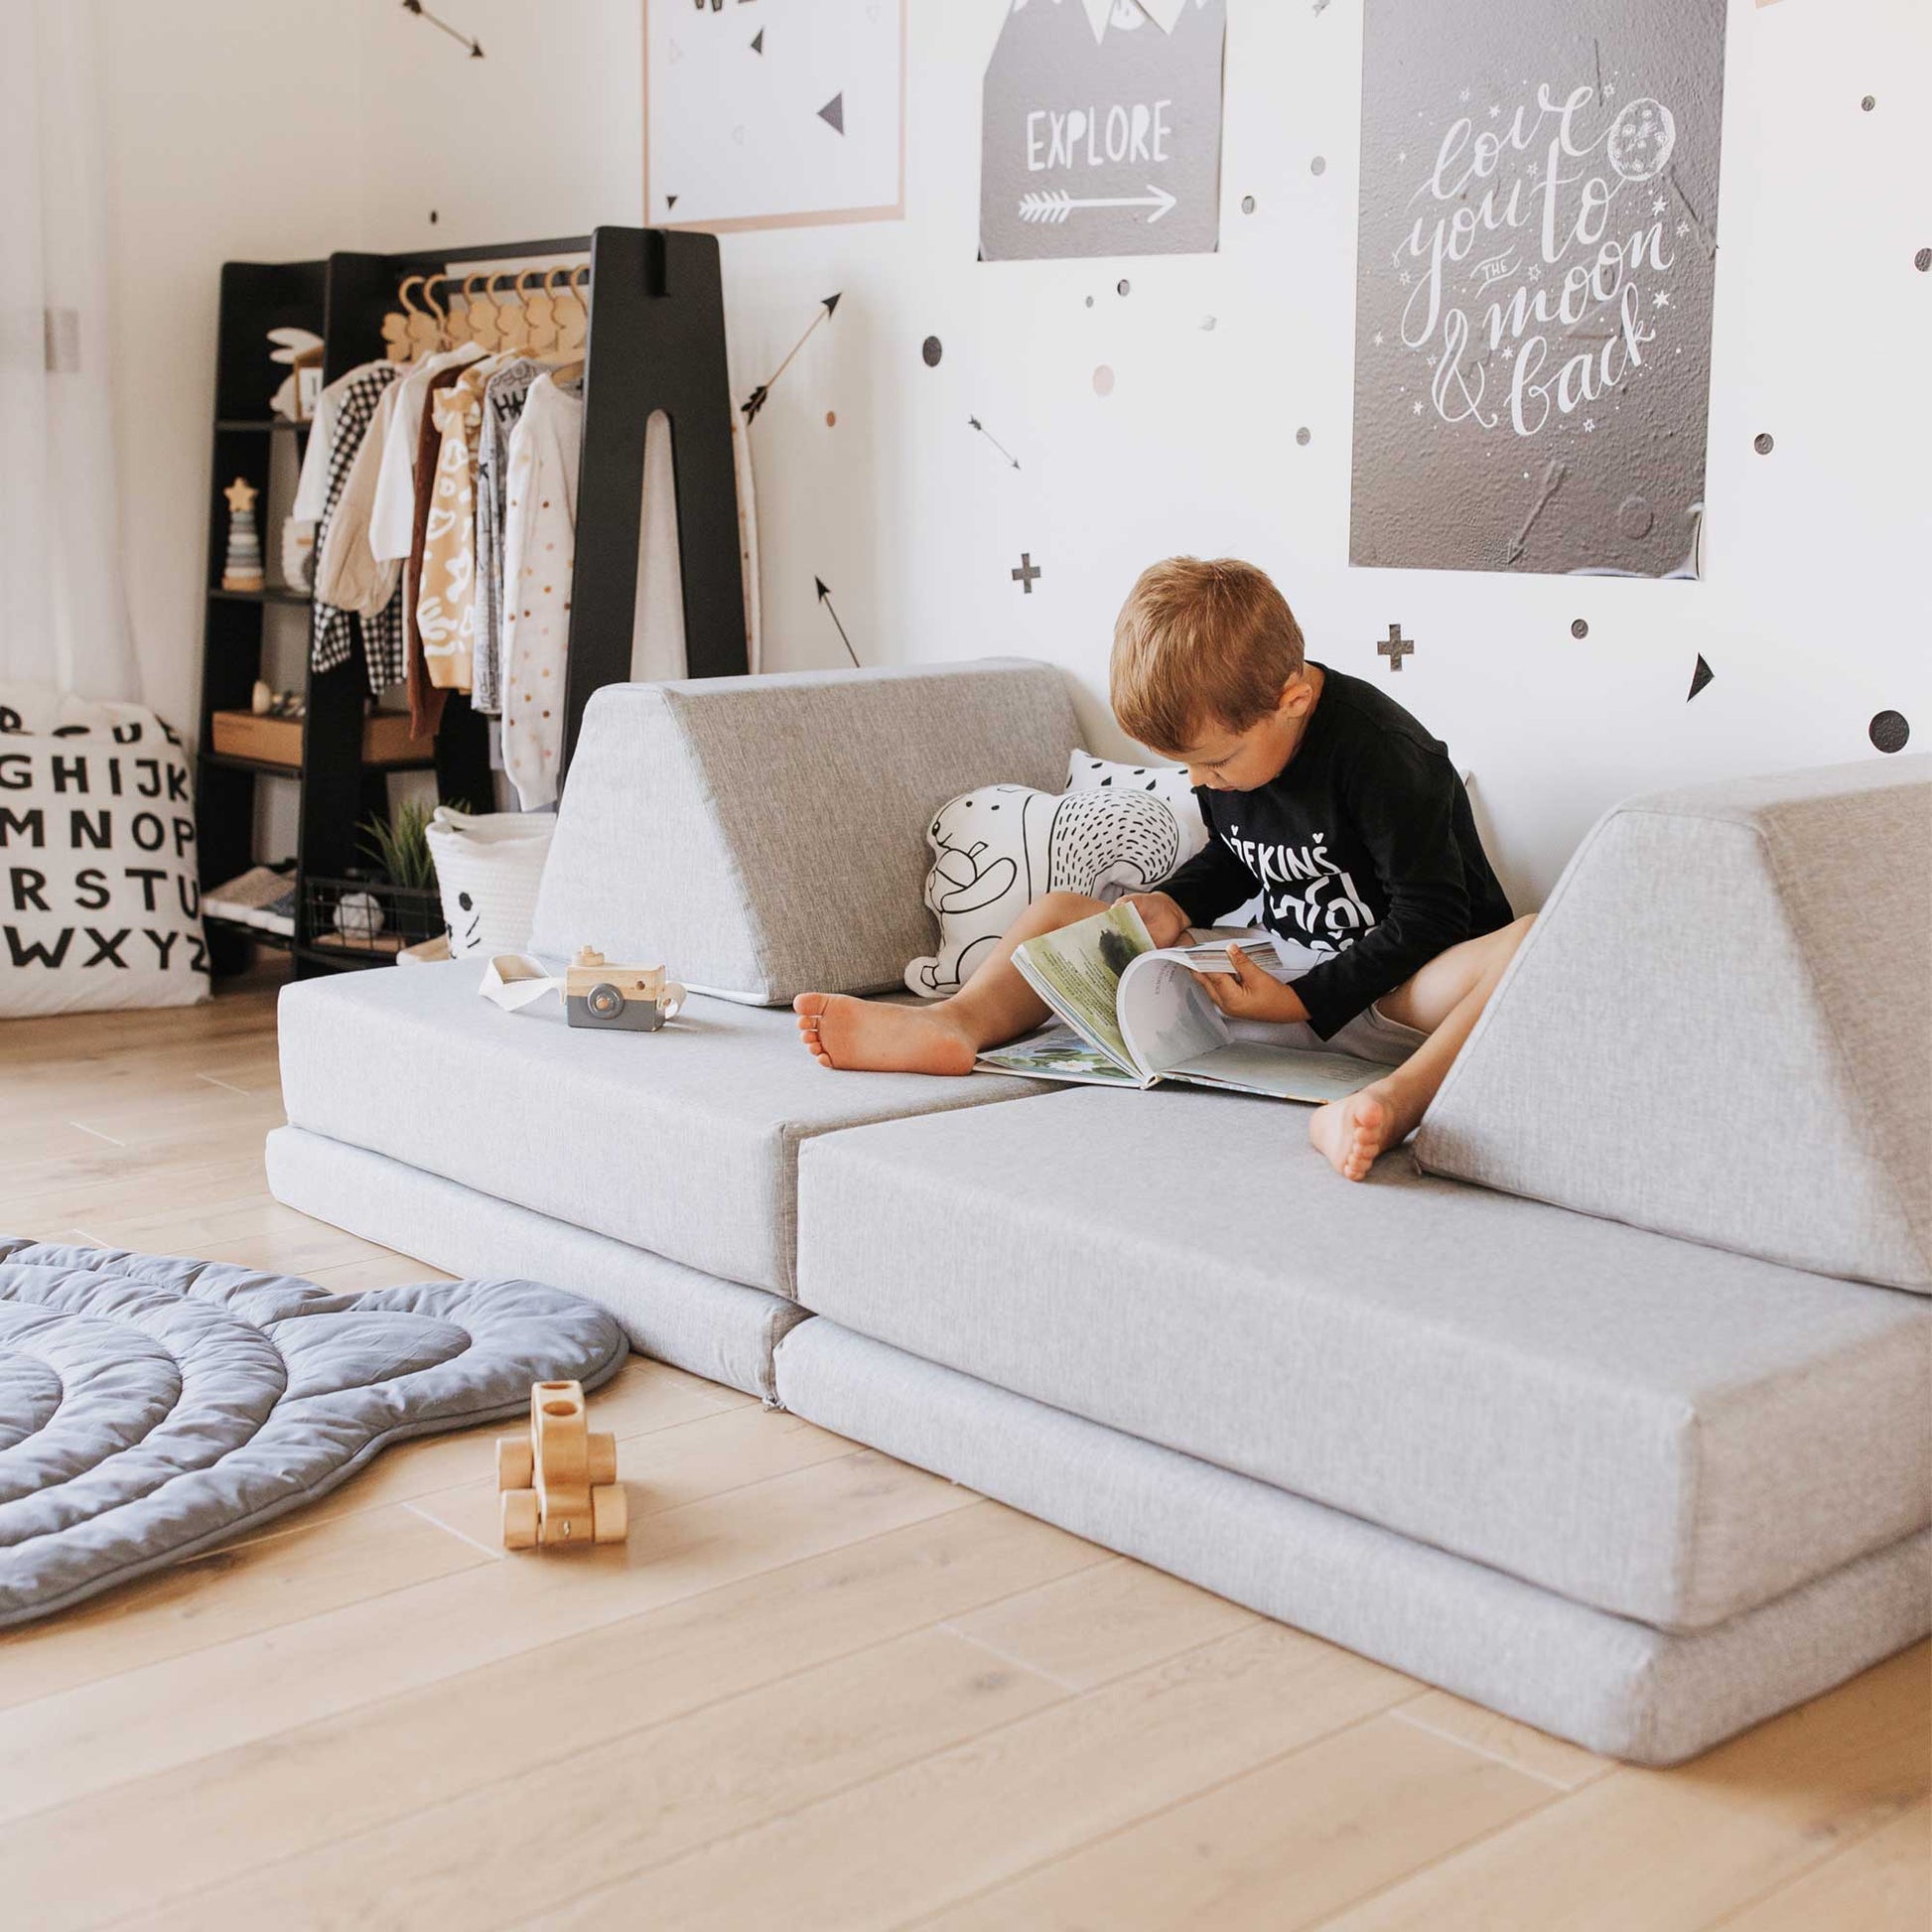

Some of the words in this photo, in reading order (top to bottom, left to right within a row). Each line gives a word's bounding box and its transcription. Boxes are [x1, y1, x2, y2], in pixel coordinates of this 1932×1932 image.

[1027, 99, 1173, 172] EXPLORE
[1408, 83, 1612, 208] love
[1392, 179, 1531, 347] you
[1530, 137, 1620, 263] to
[1481, 260, 1508, 278] THE
[1482, 222, 1675, 350] moon
[1432, 309, 1498, 429] &
[1503, 282, 1656, 437] back
